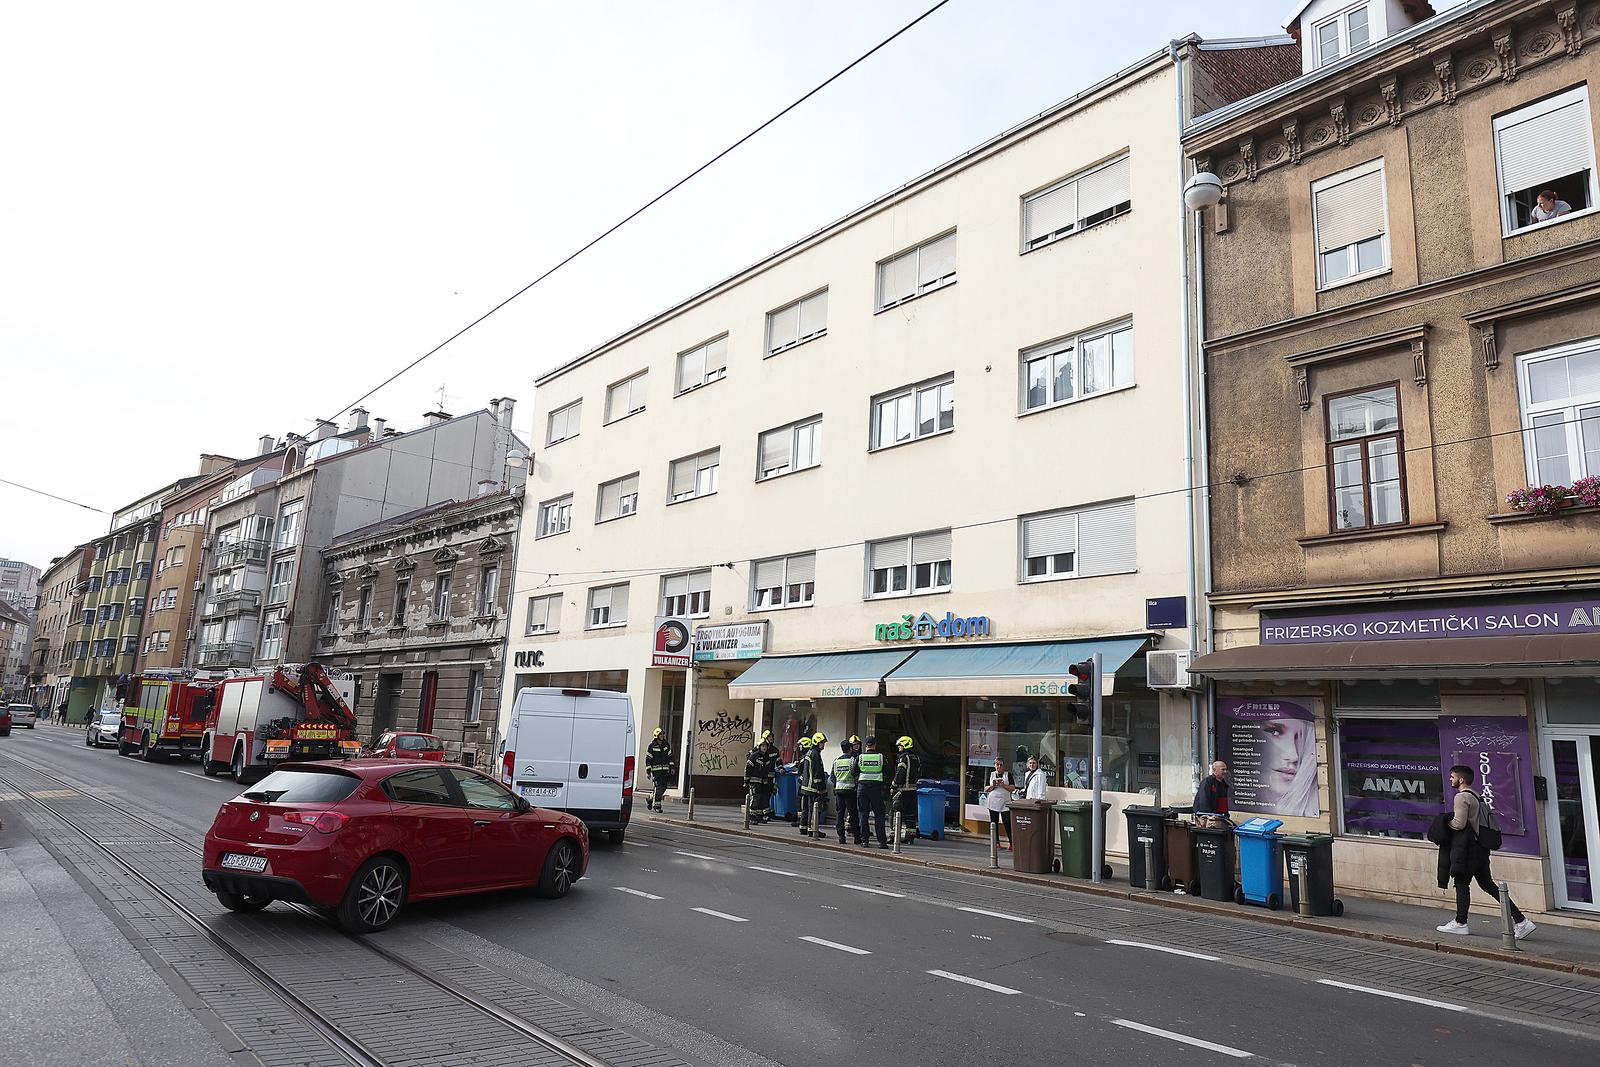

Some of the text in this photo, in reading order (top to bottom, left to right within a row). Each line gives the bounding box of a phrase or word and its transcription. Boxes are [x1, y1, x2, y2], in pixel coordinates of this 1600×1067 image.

[875, 611, 989, 641] naš dom
[1265, 623, 1357, 640] FRIZERSKO
[1363, 613, 1479, 636] KOZMETIČKI
[1485, 612, 1560, 630] SALON
[696, 642, 701, 651] &
[702, 639, 738, 651] VULKANIZER
[654, 656, 689, 666] VULKANIZER
[821, 685, 862, 696] naš dom
[1025, 682, 1047, 695] naš
[1362, 777, 1426, 794] ANAVI
[1479, 751, 1496, 810] SOLAR
[1202, 848, 1216, 856] PAPIR
